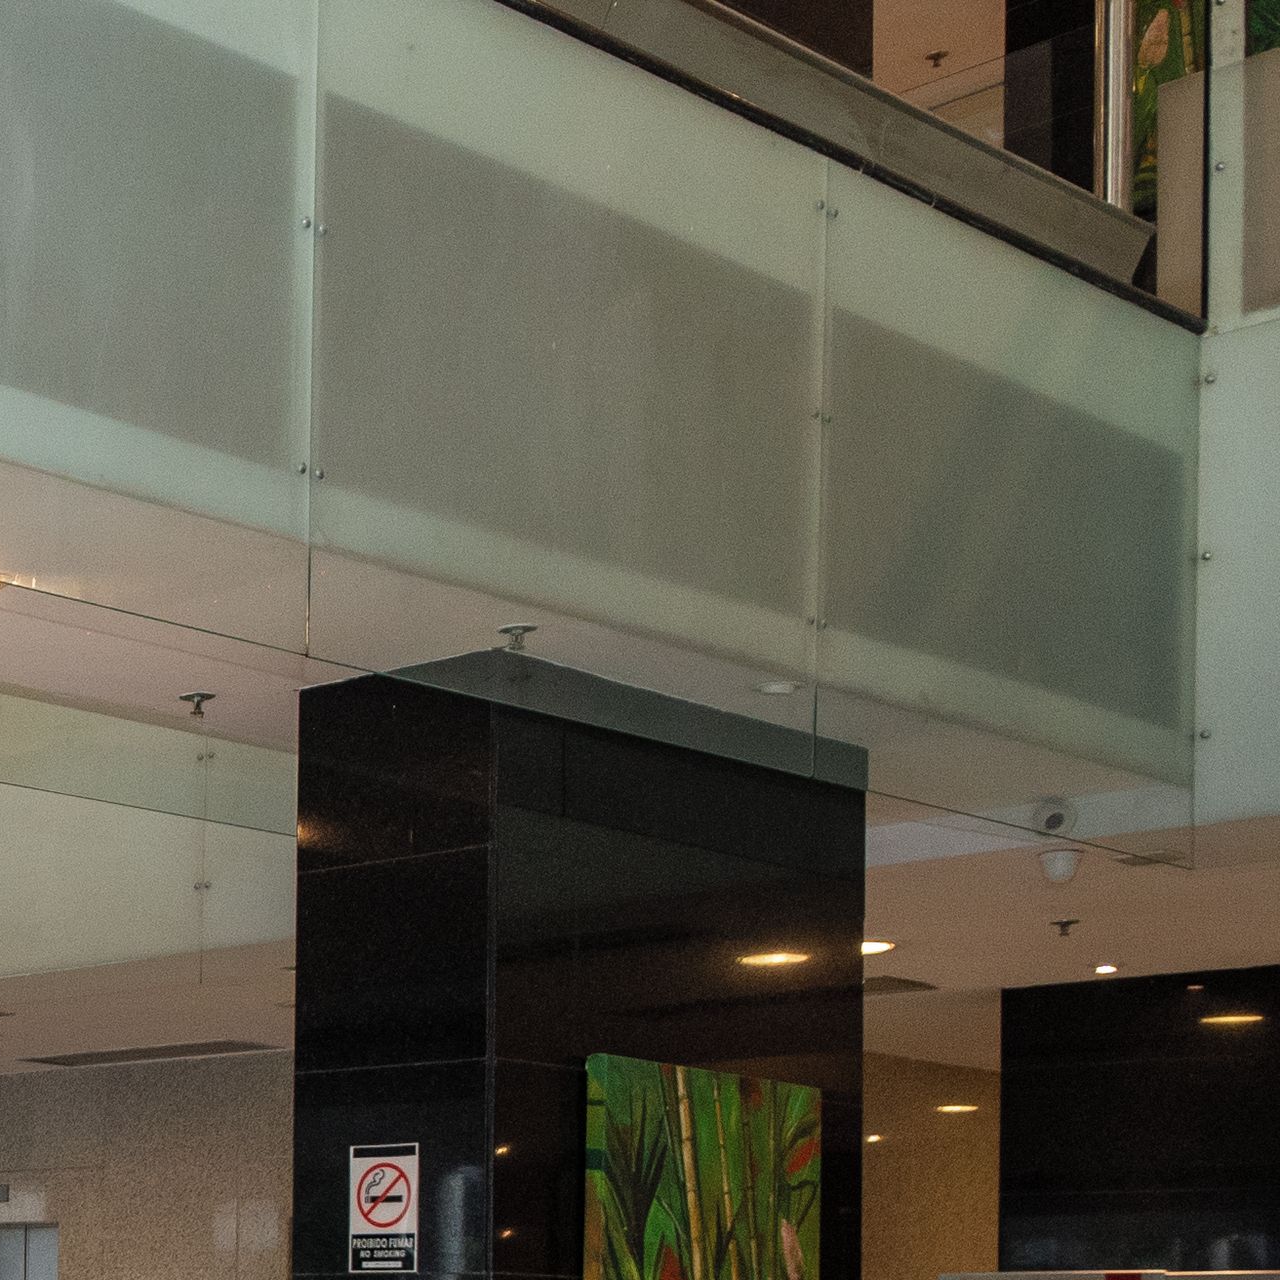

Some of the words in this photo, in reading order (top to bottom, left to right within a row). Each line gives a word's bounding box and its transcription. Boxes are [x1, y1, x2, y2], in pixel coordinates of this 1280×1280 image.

[352, 1238, 387, 1248] PROIBIDO
[359, 1250, 371, 1258] NO
[374, 1250, 405, 1258] SMOKING
